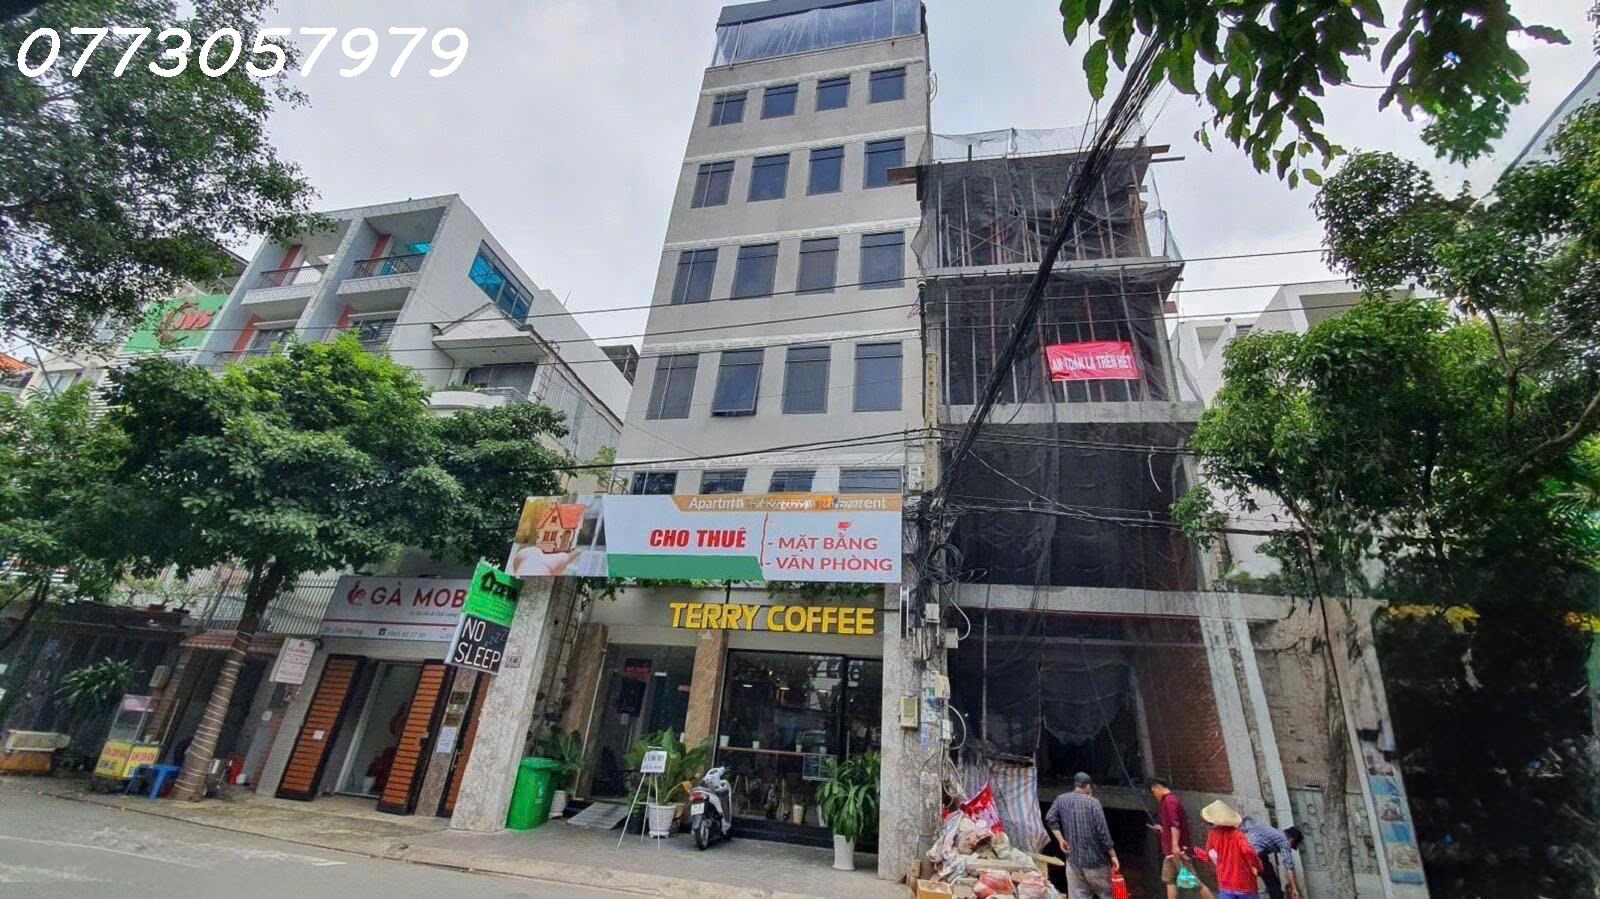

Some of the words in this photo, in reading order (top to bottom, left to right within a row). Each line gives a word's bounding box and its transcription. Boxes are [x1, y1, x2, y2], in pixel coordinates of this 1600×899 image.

[649, 529, 690, 548] CHO
[696, 527, 747, 548] THUÊ
[778, 534, 818, 553] MẶT
[823, 528, 878, 550] BẰNG
[776, 554, 815, 570] VĂN
[820, 554, 893, 571] PHÒNG
[371, 581, 402, 606] GÀ
[461, 617, 486, 642] NO
[669, 602, 763, 631] TERRY
[767, 604, 875, 635] COFFEE
[454, 642, 501, 669] SLEEP
